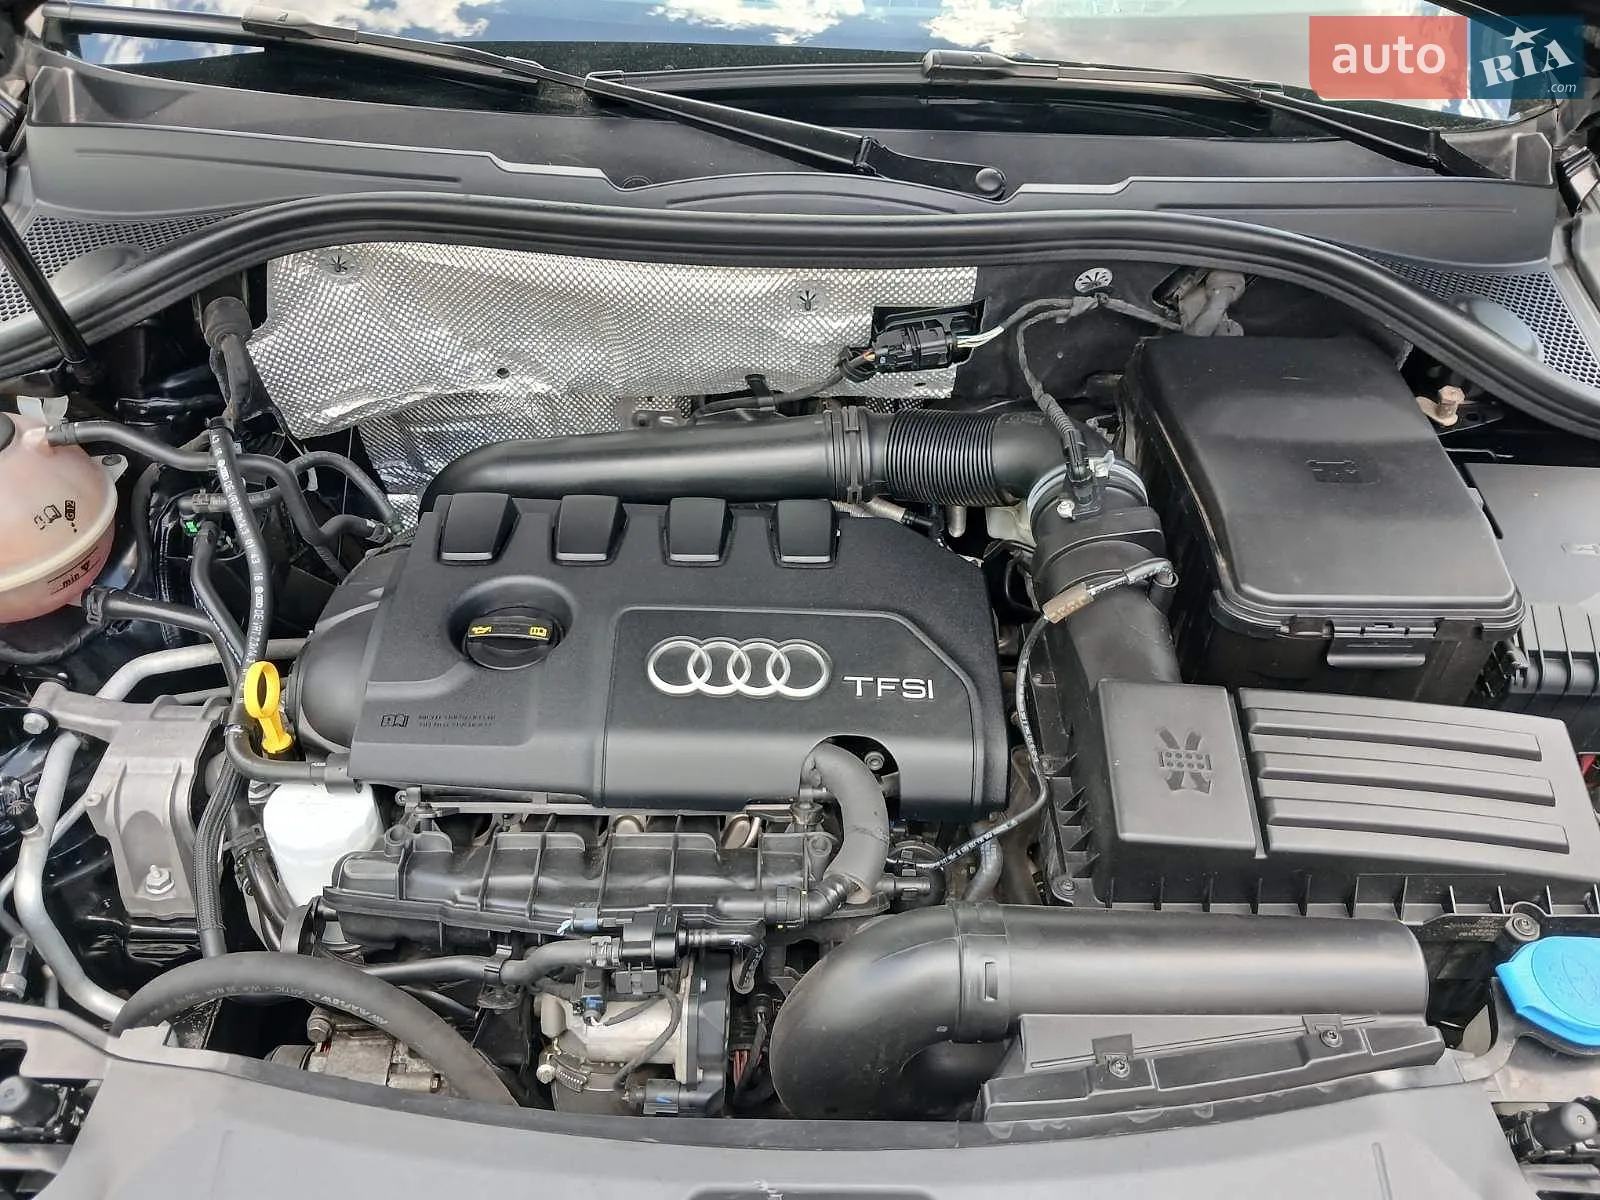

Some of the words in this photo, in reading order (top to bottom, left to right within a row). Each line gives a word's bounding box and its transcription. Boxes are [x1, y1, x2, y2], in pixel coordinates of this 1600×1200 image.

[65, 500, 75, 519] G12
[61, 573, 80, 588] min
[843, 676, 934, 699] TFSI
